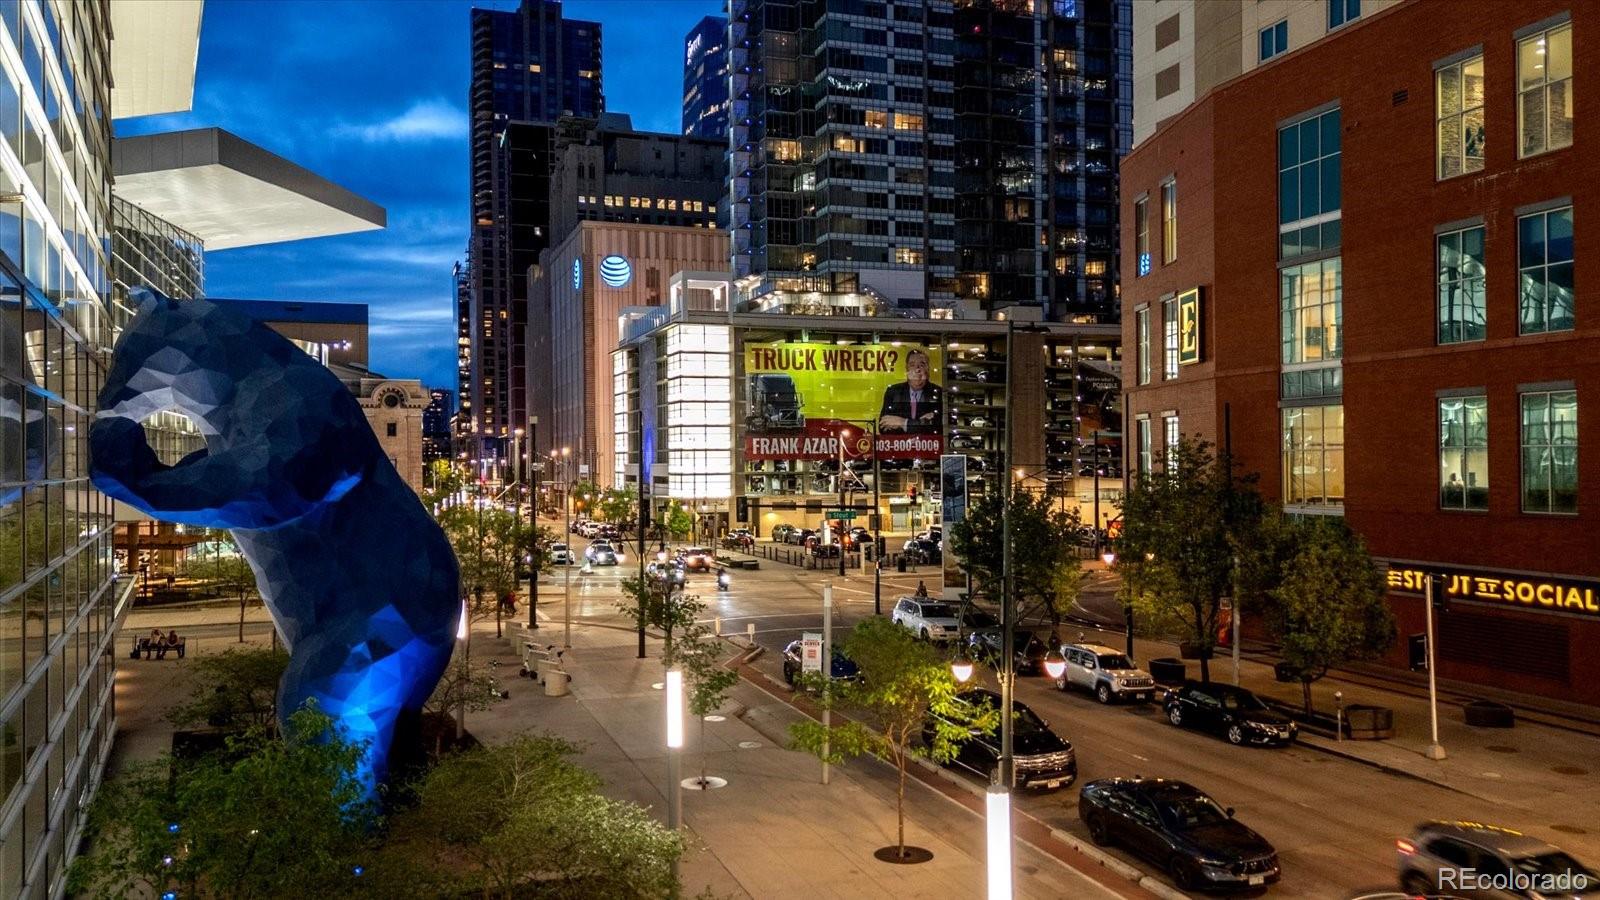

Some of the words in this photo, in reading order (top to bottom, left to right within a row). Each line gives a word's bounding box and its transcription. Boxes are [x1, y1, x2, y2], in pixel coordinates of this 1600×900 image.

[752, 348, 816, 370] TRUCK
[822, 349, 898, 372] WRECK?
[752, 437, 798, 454] FRANK
[802, 437, 838, 454] AZAR
[1403, 570, 1470, 595] STUT
[1478, 582, 1497, 593] ST
[1503, 580, 1599, 611] SOCIAL
